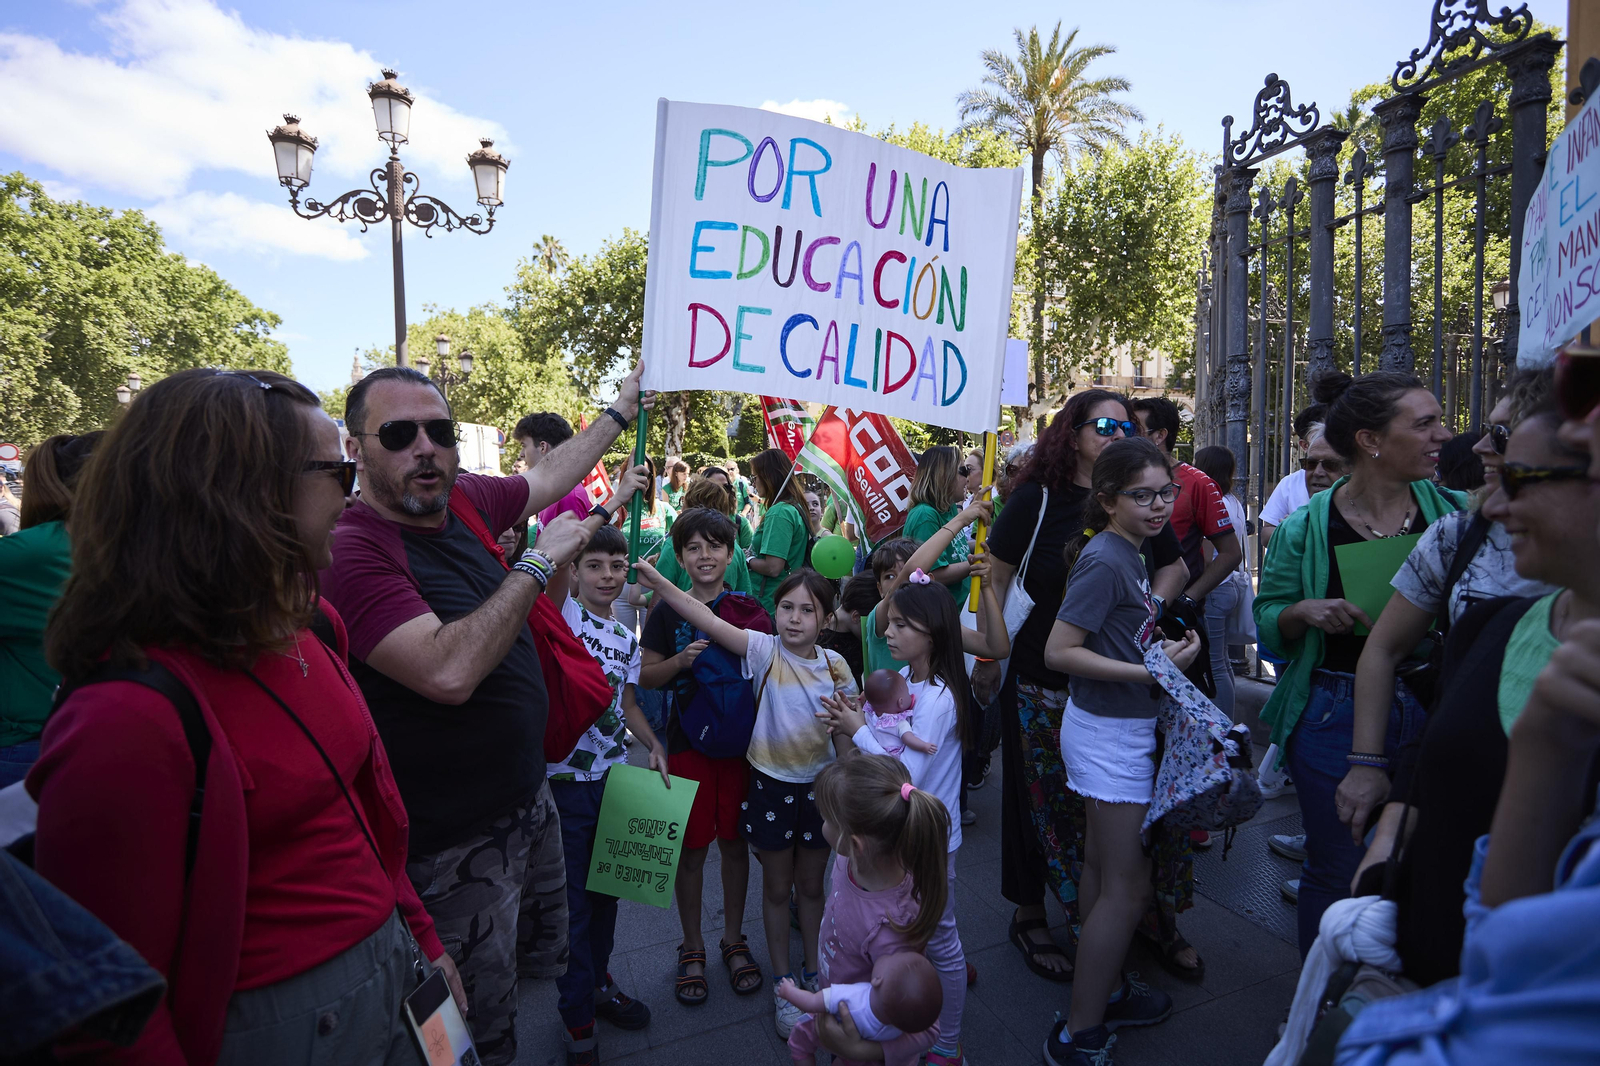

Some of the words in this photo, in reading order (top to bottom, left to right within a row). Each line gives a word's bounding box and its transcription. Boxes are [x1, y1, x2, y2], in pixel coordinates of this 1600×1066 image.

[694, 128, 832, 218] POR
[865, 162, 950, 252] UNA
[1559, 175, 1597, 228] EL
[1557, 209, 1600, 278] MAN
[689, 219, 968, 332] EDUCACIÓN
[688, 303, 772, 373] DE
[780, 313, 968, 407] CALIDAD
[854, 466, 892, 524] Sevilla
[628, 817, 666, 839] AÑOS
[667, 822, 680, 841] 3
[596, 862, 611, 874] DE
[605, 837, 674, 867] INFANTIL
[615, 864, 653, 888] LÍNEA
[654, 872, 669, 893] 2
